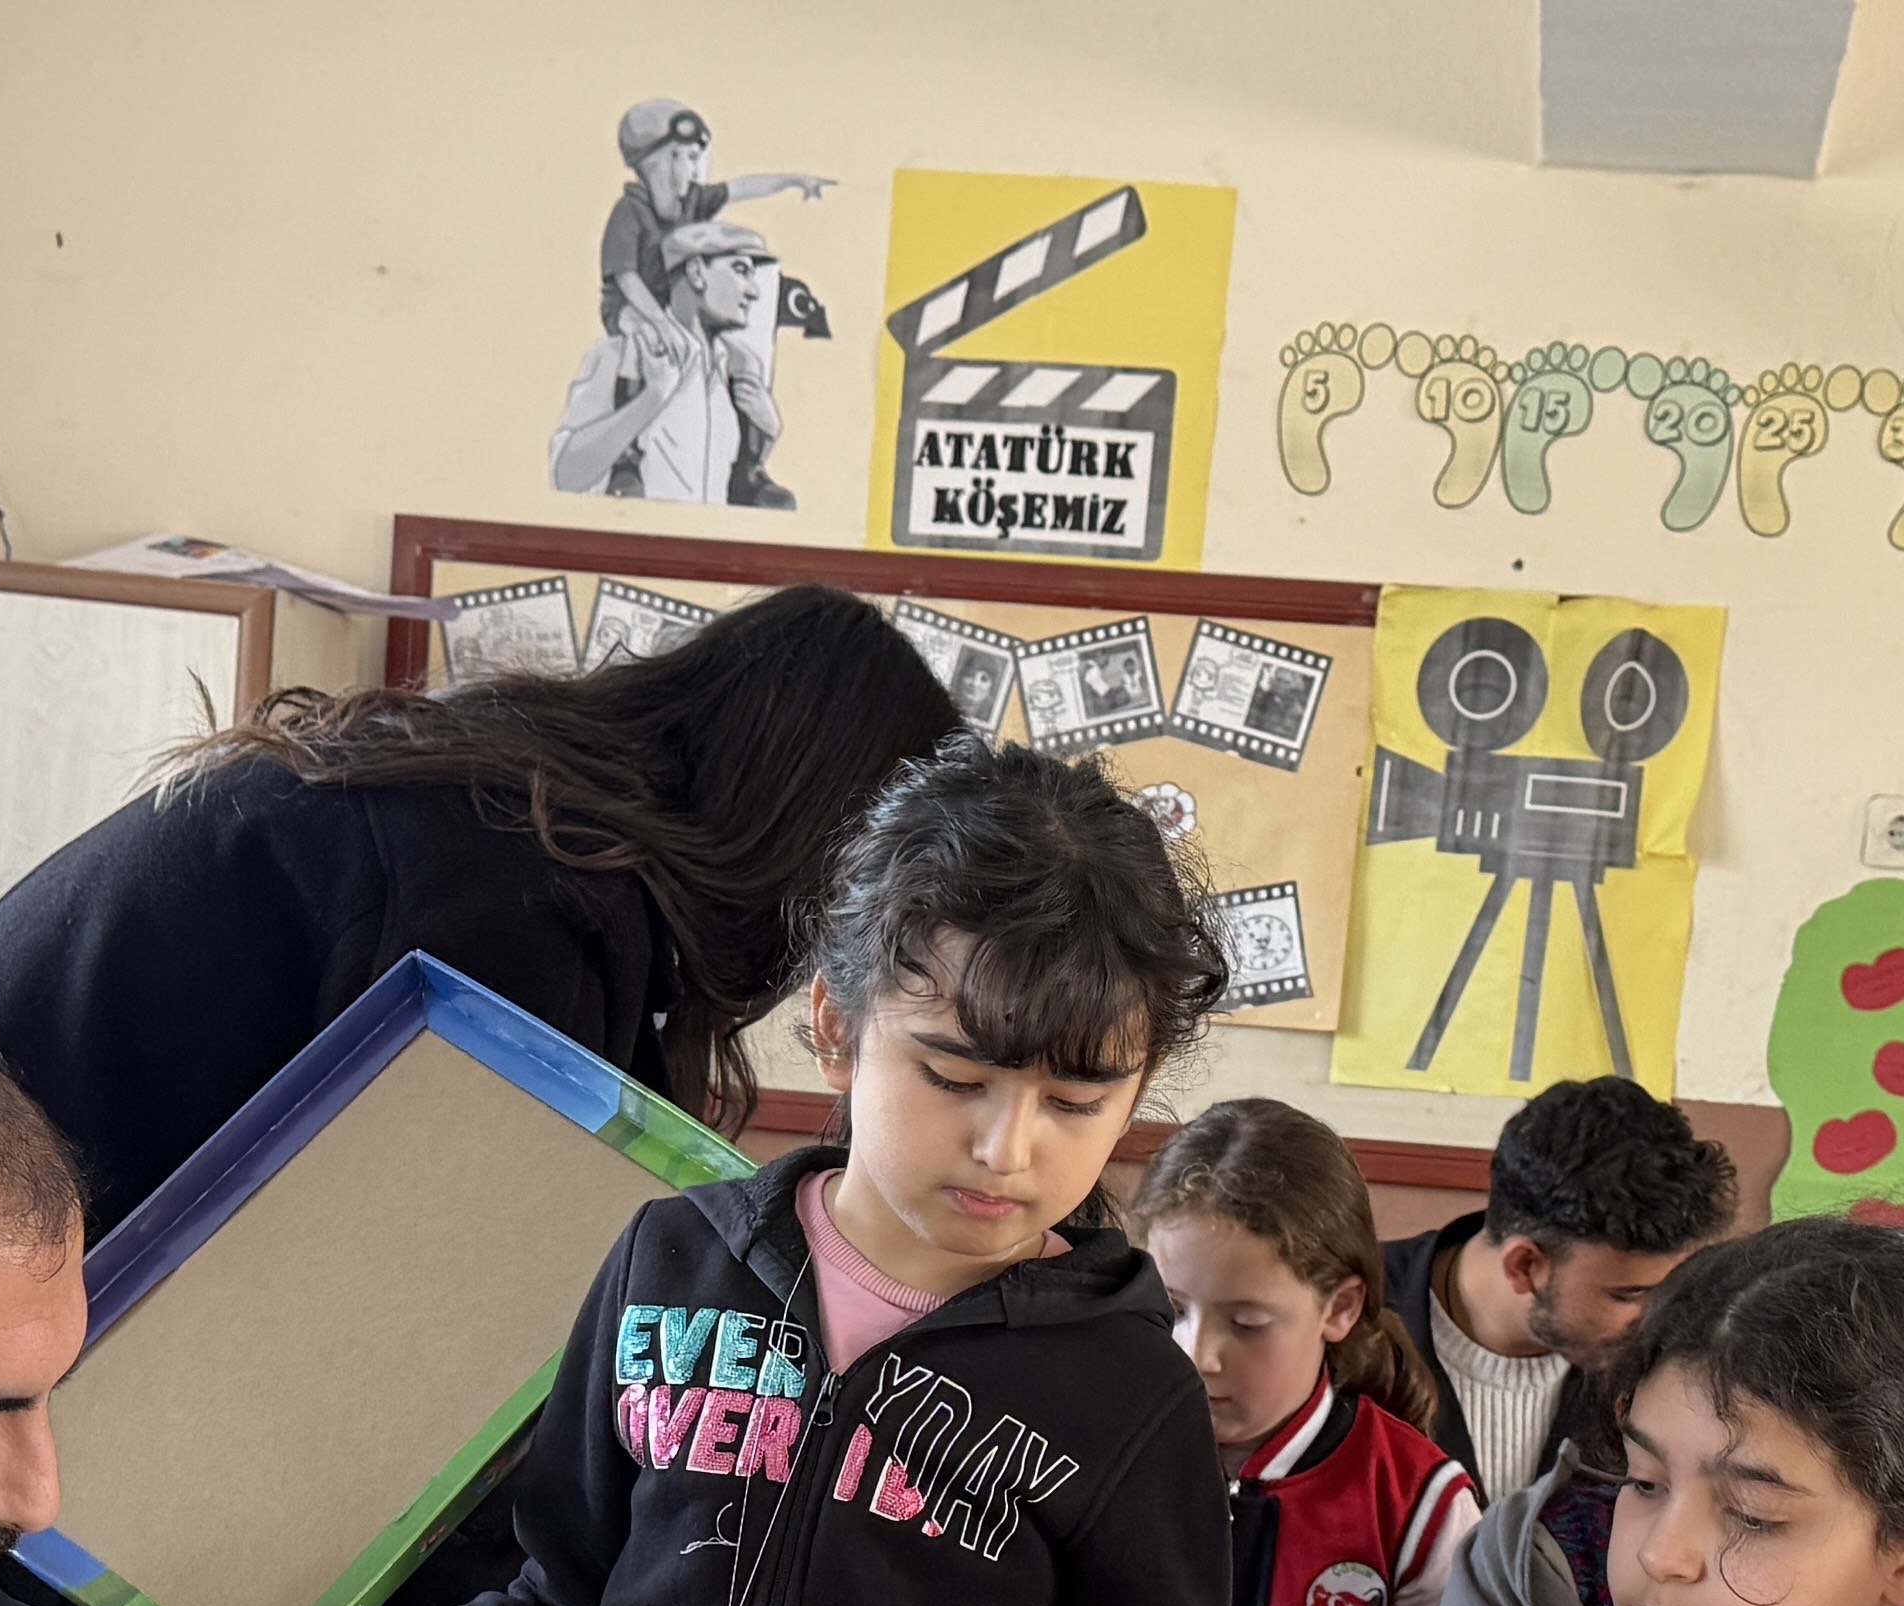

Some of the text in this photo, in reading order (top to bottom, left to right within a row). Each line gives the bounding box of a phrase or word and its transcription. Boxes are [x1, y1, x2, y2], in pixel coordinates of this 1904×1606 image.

[1302, 371, 1331, 414] 5
[1425, 377, 1495, 423] 10
[1519, 387, 1573, 432] 15
[1650, 401, 1728, 446] 20
[1753, 406, 1817, 452] 25
[915, 423, 1138, 480] ATATÜRK
